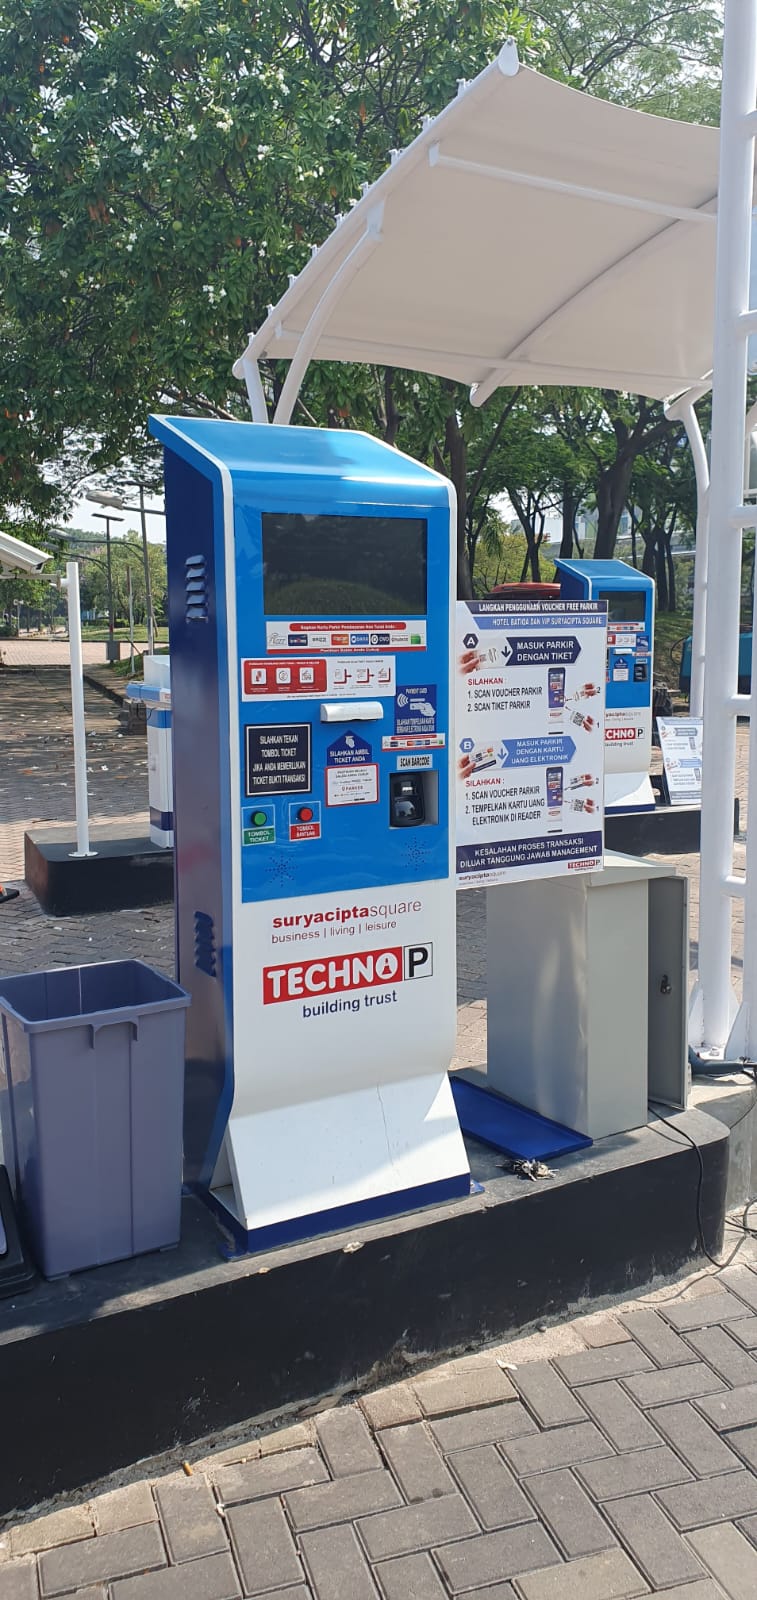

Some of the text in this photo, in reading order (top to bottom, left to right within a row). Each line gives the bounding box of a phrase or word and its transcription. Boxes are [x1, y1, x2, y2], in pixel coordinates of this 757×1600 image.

[479, 603, 504, 612] LANGKAH
[506, 603, 540, 611] PENGGUNAAN
[467, 637, 475, 645] A
[517, 640, 574, 650] MASUK PARKIR
[517, 652, 572, 661] DENGAN TIKET
[474, 690, 490, 698] SCAN
[492, 688, 520, 697] VOUCHER
[521, 687, 542, 696] PARKIR
[468, 700, 530, 712] 2. SCAN TIKET PARKIR
[606, 729, 643, 738] CHNO P
[260, 735, 298, 744] SILAHKAN TEKAN
[261, 748, 296, 758] TOMBOL TICKET
[265, 762, 276, 771] ANDA
[400, 757, 430, 767] SCAN BARCODE
[253, 776, 268, 784] TICKET
[282, 774, 305, 783] TRANSAKSI
[466, 778, 501, 787] SILAHKAN
[472, 791, 488, 800] SCAN
[490, 788, 518, 798] VOUCHER
[519, 786, 540, 796] PARKIR
[472, 803, 507, 813] TEMPELKAN
[508, 800, 528, 810] KARTU
[529, 799, 545, 808] UANG
[472, 810, 540, 826] ELEKTRONIK DI READER
[475, 838, 584, 856] KESALAHAN PROSES TRANSAKSI
[460, 846, 597, 868] DILUAR TANGGUNG JAWAB MANAGEMENT
[273, 900, 421, 928] suryaciptasquare
[272, 930, 320, 944] business
[330, 925, 355, 937] living
[365, 920, 396, 931] leisure
[267, 947, 428, 998] TECHNO P
[303, 990, 397, 1018] building trust
